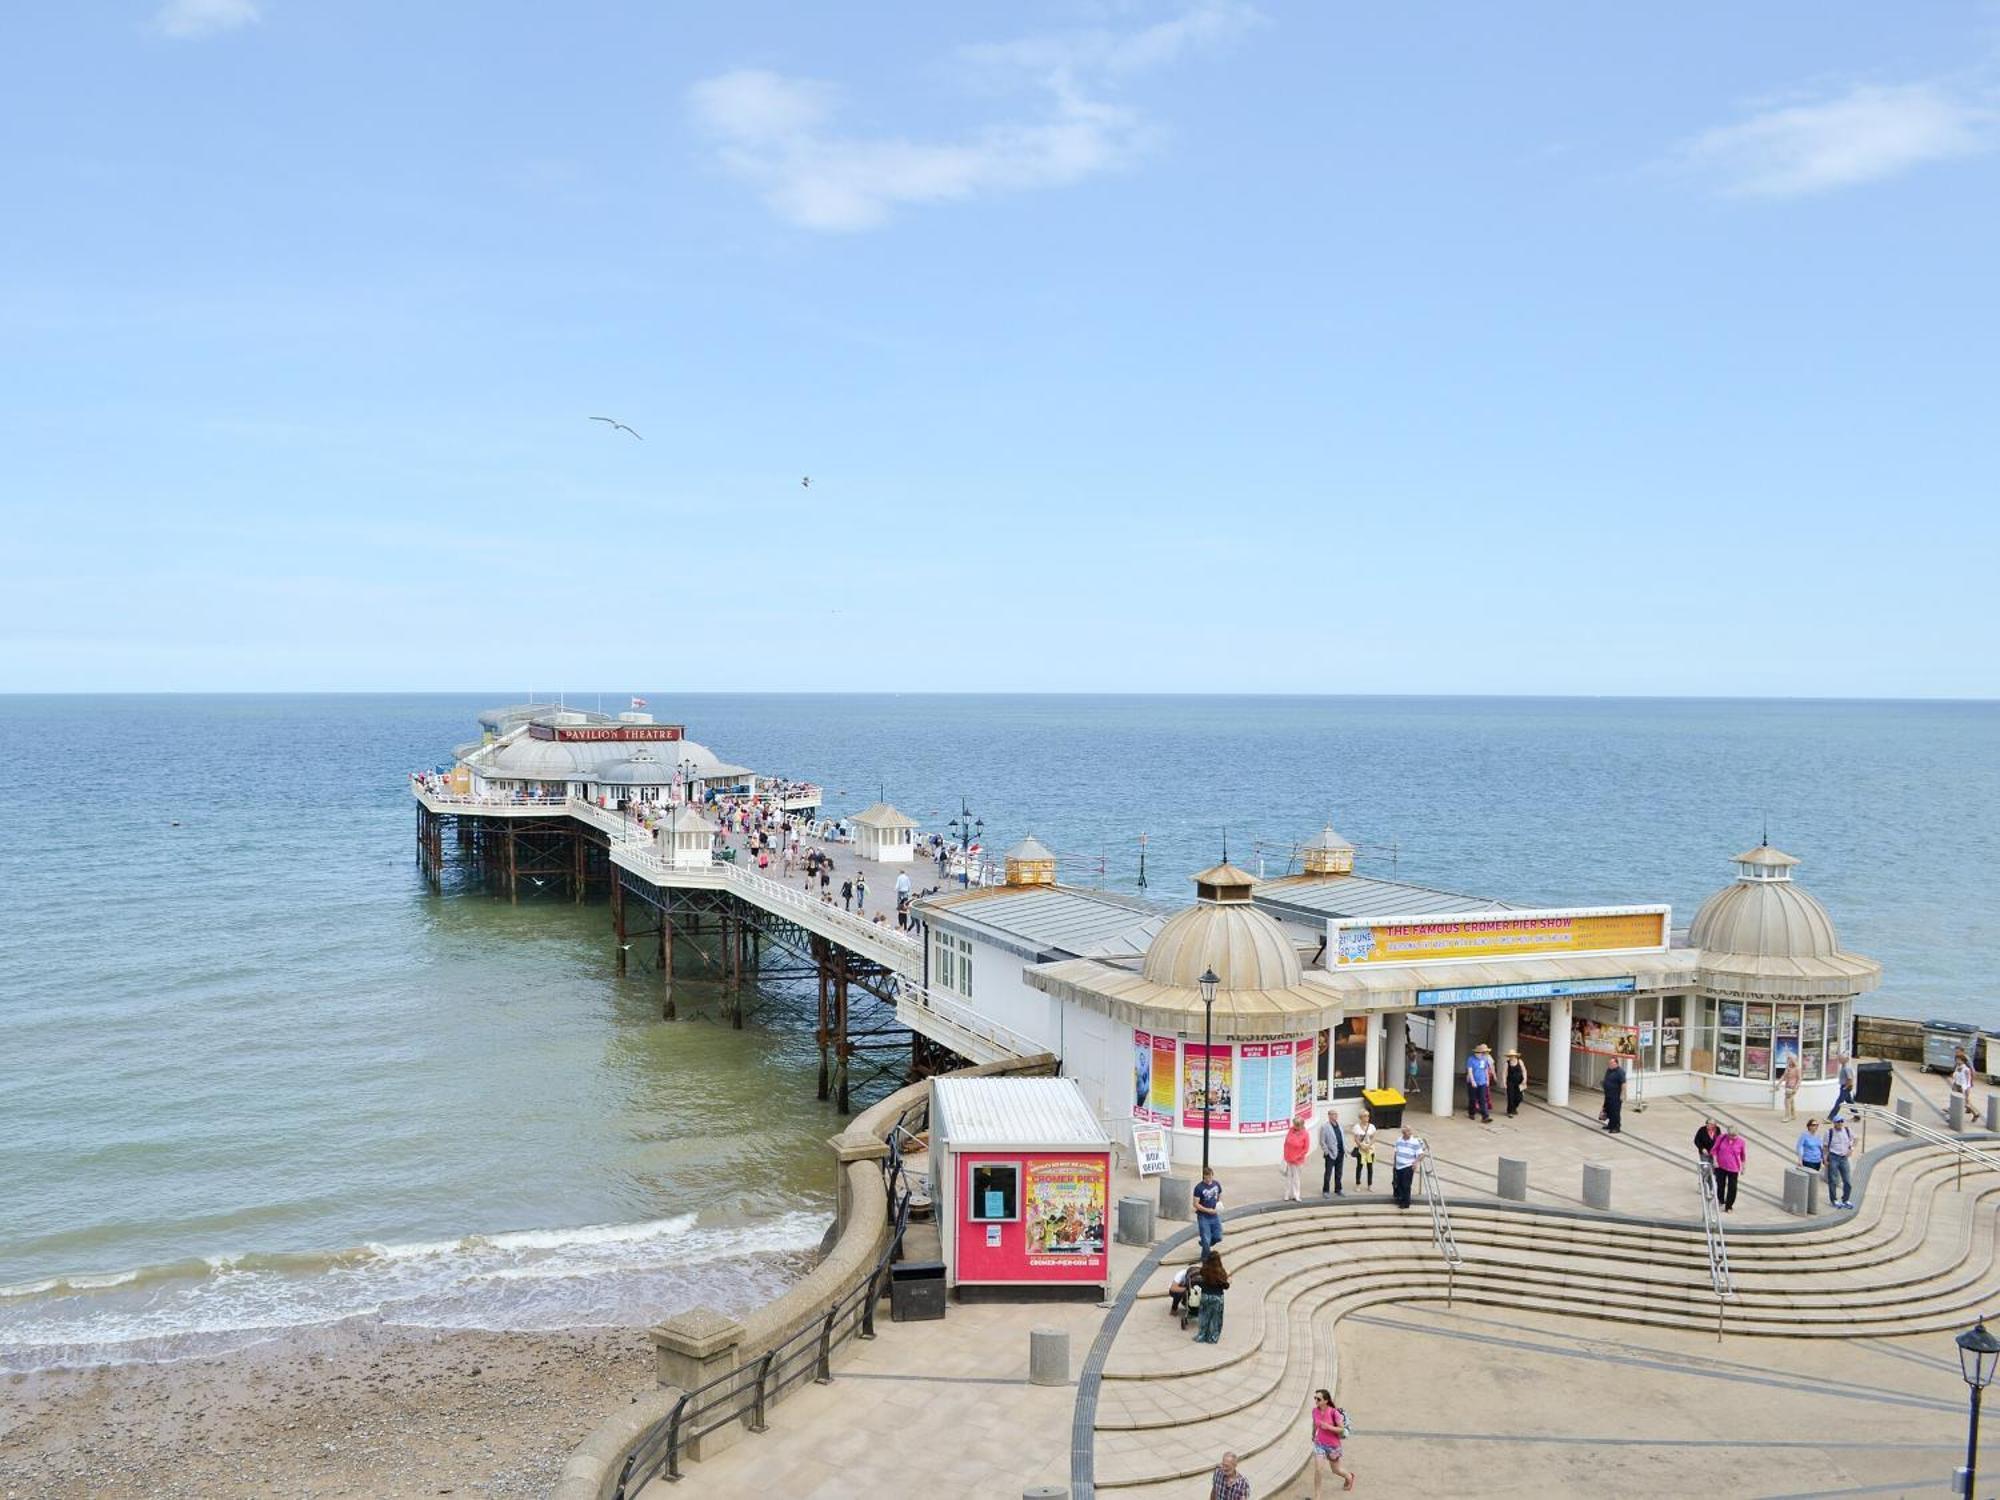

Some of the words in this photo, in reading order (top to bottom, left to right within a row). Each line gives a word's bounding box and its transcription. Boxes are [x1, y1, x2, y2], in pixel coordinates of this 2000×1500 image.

[566, 730, 618, 739] PAVILION
[624, 730, 673, 739] THEATRE
[1386, 925, 1410, 937] THE
[1412, 923, 1460, 936] FAMOUS
[1463, 920, 1510, 933] CROMER
[1513, 919, 1537, 930] PIER
[1540, 917, 1572, 929] SHOW
[1353, 931, 1372, 944] JUNE
[1357, 943, 1376, 955] SEPT
[1471, 987, 1506, 1001] CROMER
[1508, 984, 1529, 998] PIER
